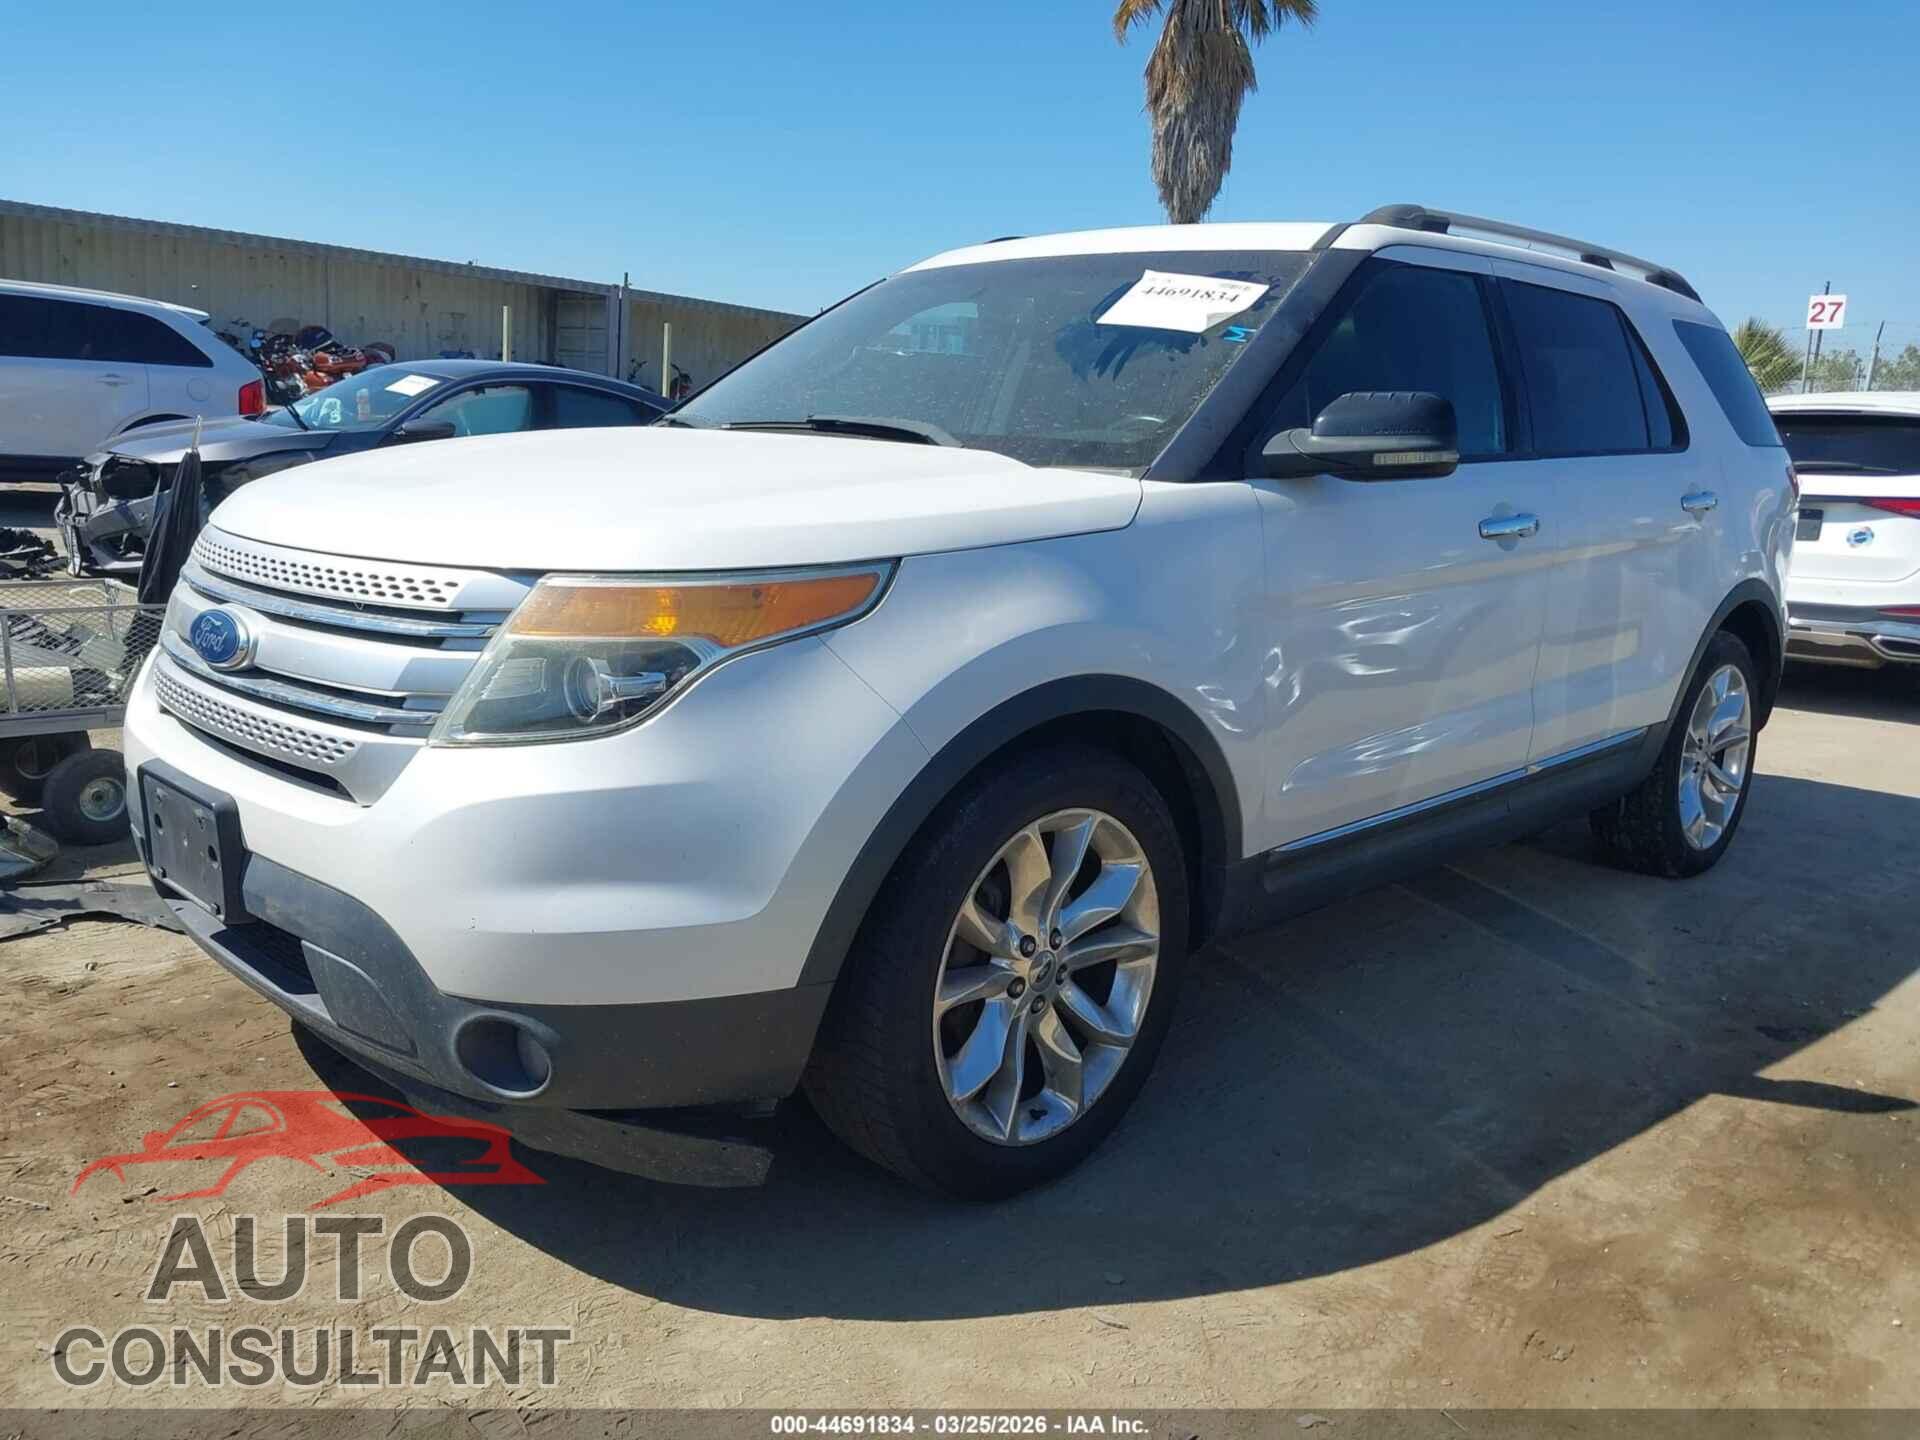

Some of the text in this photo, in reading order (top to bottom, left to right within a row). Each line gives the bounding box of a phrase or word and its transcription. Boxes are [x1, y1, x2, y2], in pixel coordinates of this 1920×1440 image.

[1141, 286, 1241, 303] 44691834
[1808, 301, 1844, 323] 27
[194, 615, 229, 653] Ford
